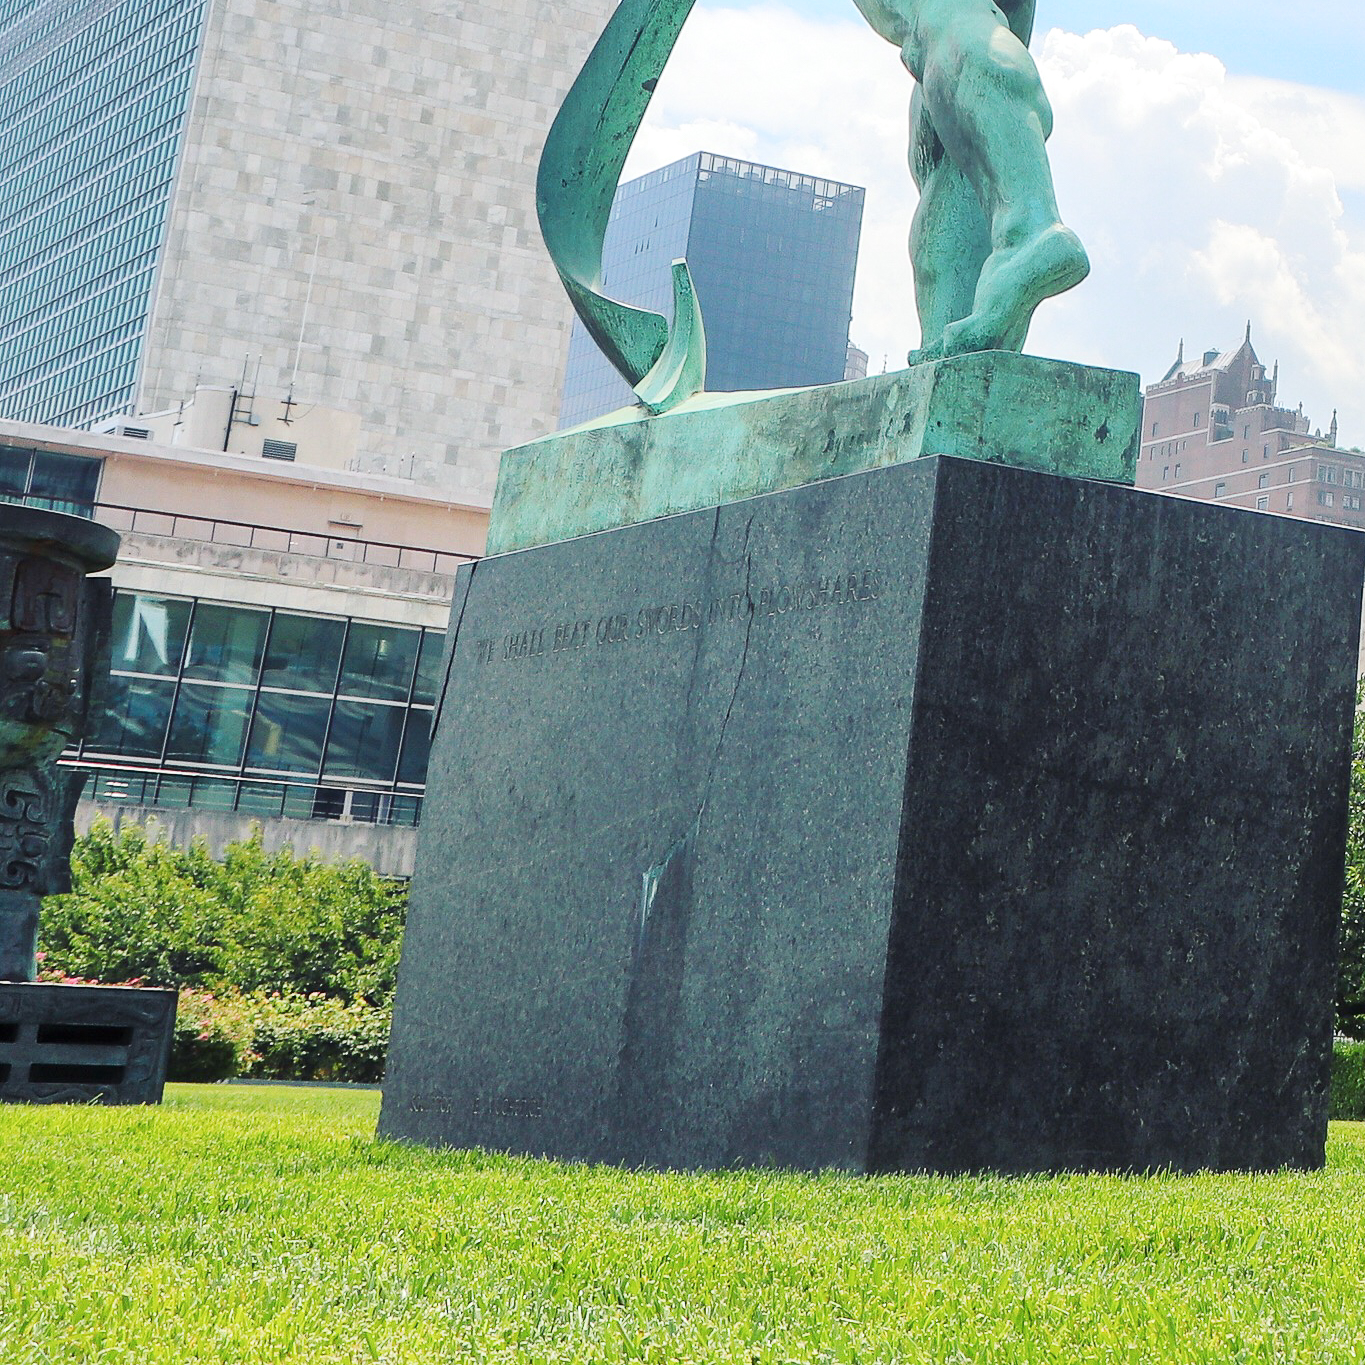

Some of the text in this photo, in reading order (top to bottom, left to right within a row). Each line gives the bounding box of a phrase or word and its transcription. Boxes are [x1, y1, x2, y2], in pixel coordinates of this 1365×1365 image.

[476, 567, 882, 666] WE SHALL BEAT OUR SWORDS INTO PLOWSHARES
